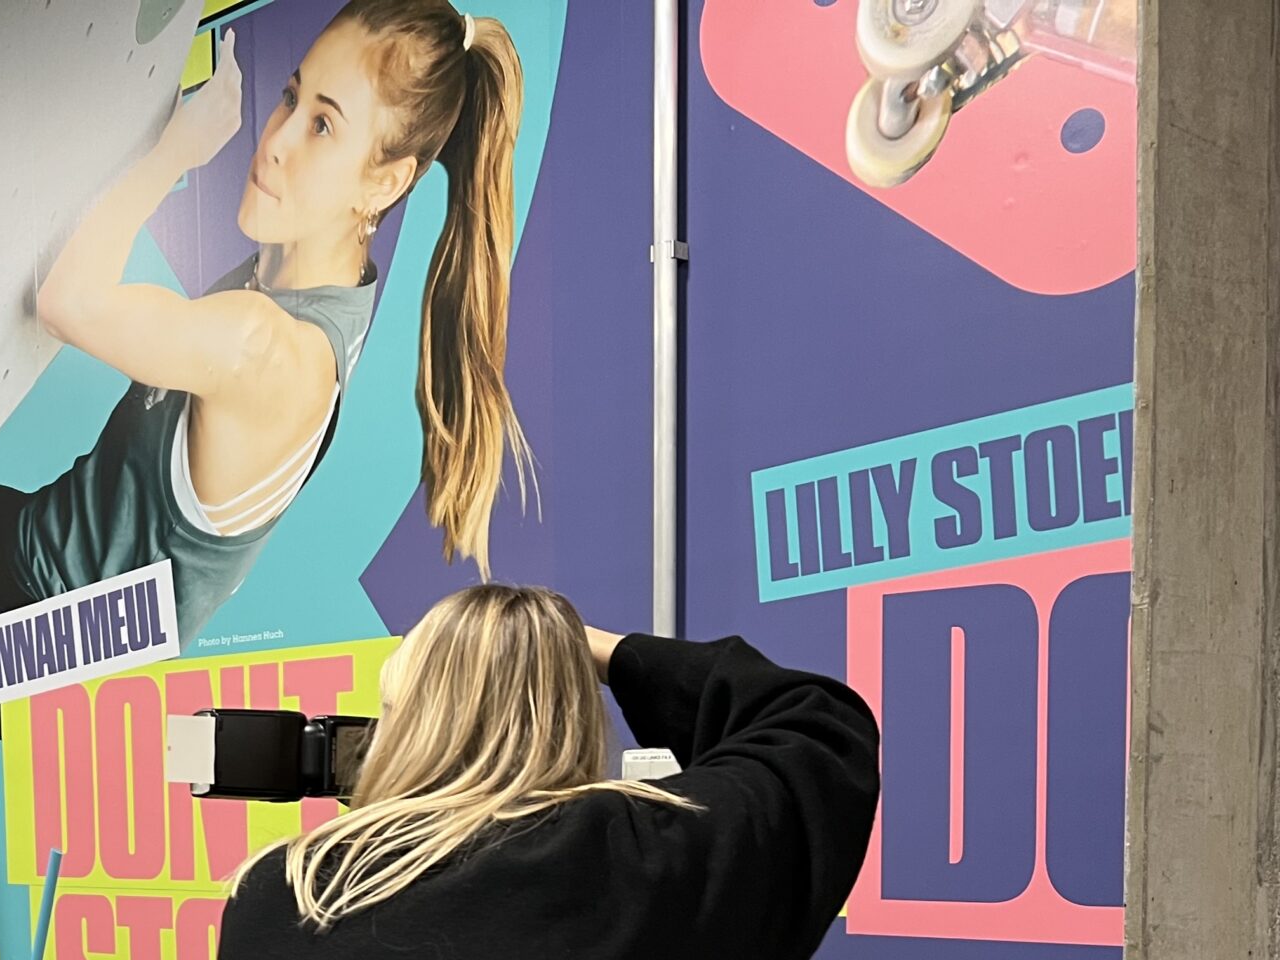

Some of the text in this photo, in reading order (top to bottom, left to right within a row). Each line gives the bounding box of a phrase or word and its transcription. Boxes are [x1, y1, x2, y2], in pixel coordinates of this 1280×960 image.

[765, 458, 917, 582] LILLY
[78, 578, 167, 666] MEUL
[198, 629, 284, 648] Photo by Hannes Huch
[29, 654, 354, 881] DON'T
